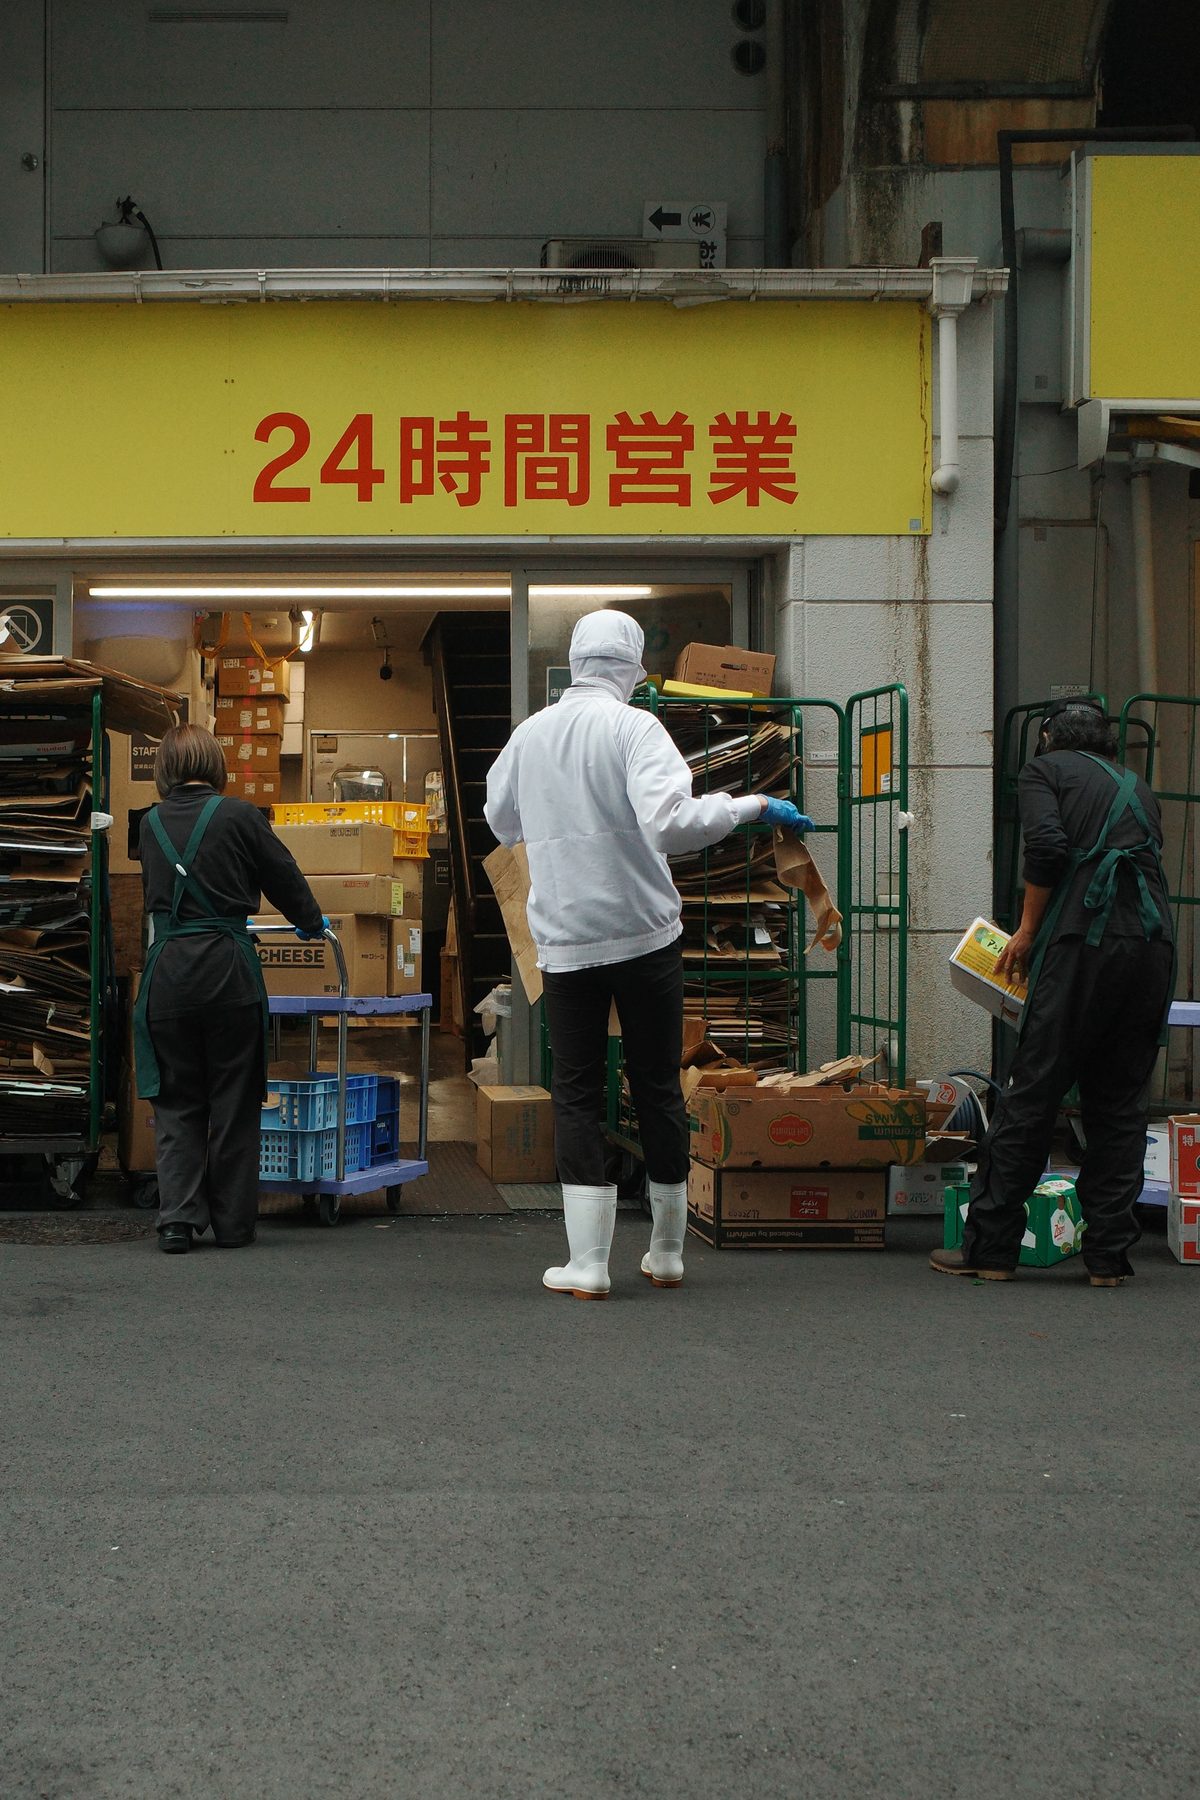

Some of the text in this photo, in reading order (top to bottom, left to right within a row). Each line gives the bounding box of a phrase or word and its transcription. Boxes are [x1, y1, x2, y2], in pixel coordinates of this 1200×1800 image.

[253, 410, 798, 507] 24時間営業
[258, 949, 324, 962] CHEESE
[873, 1127, 922, 1137] Premium
[1182, 1134, 1194, 1147] 特
[758, 1230, 768, 1238] by
